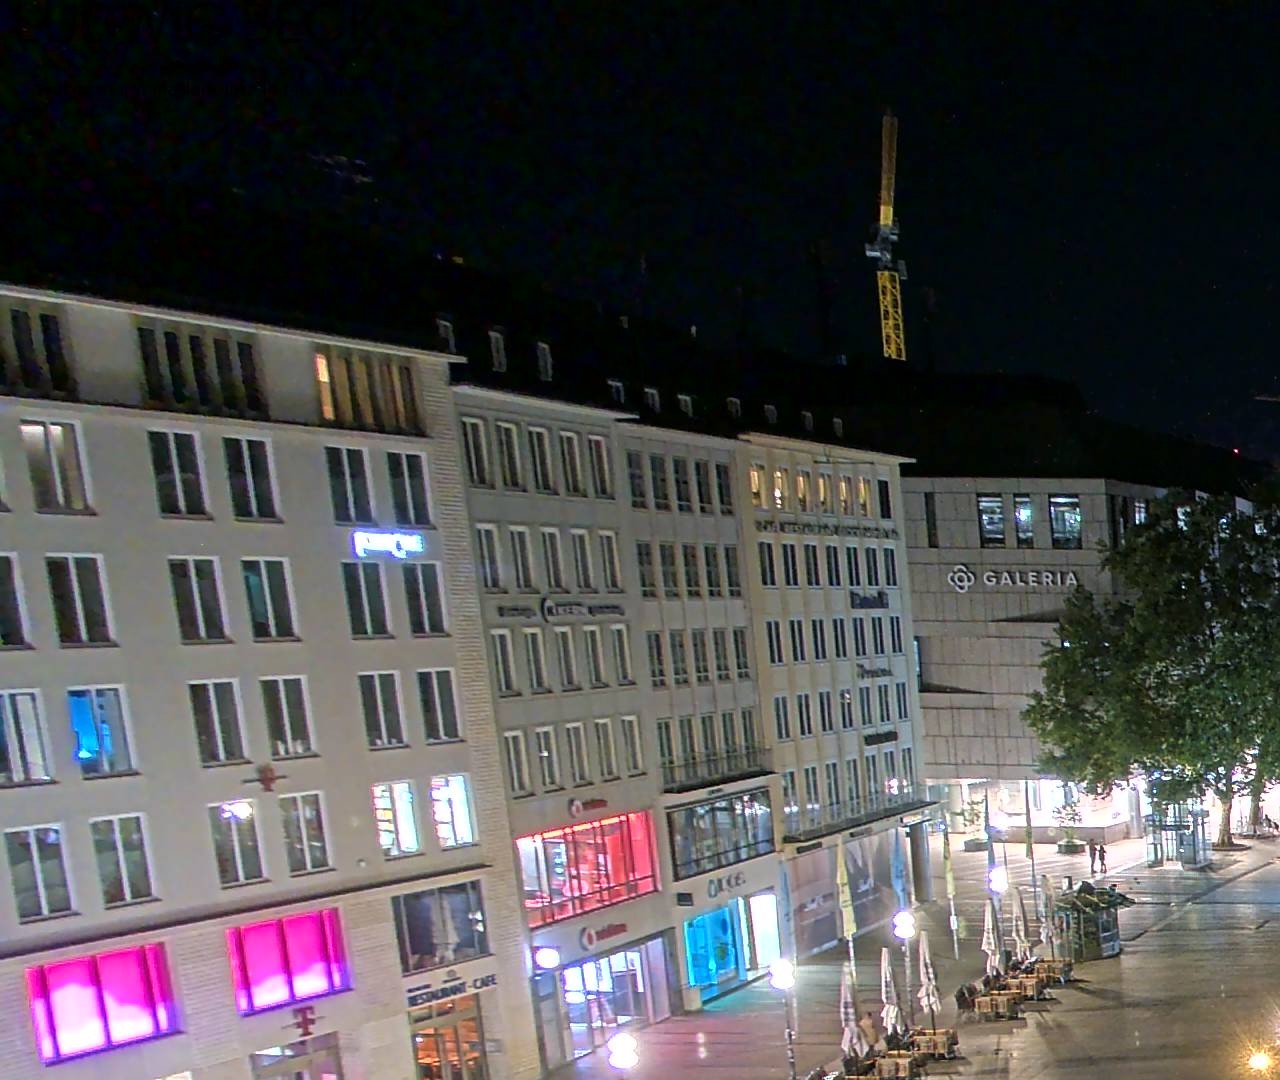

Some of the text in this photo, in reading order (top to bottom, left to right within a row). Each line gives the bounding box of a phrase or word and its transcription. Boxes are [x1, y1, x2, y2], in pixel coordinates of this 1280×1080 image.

[983, 571, 1077, 587] GALERIA
[408, 981, 467, 1007] RESTAURANT
[473, 973, 497, 990] CAFE
